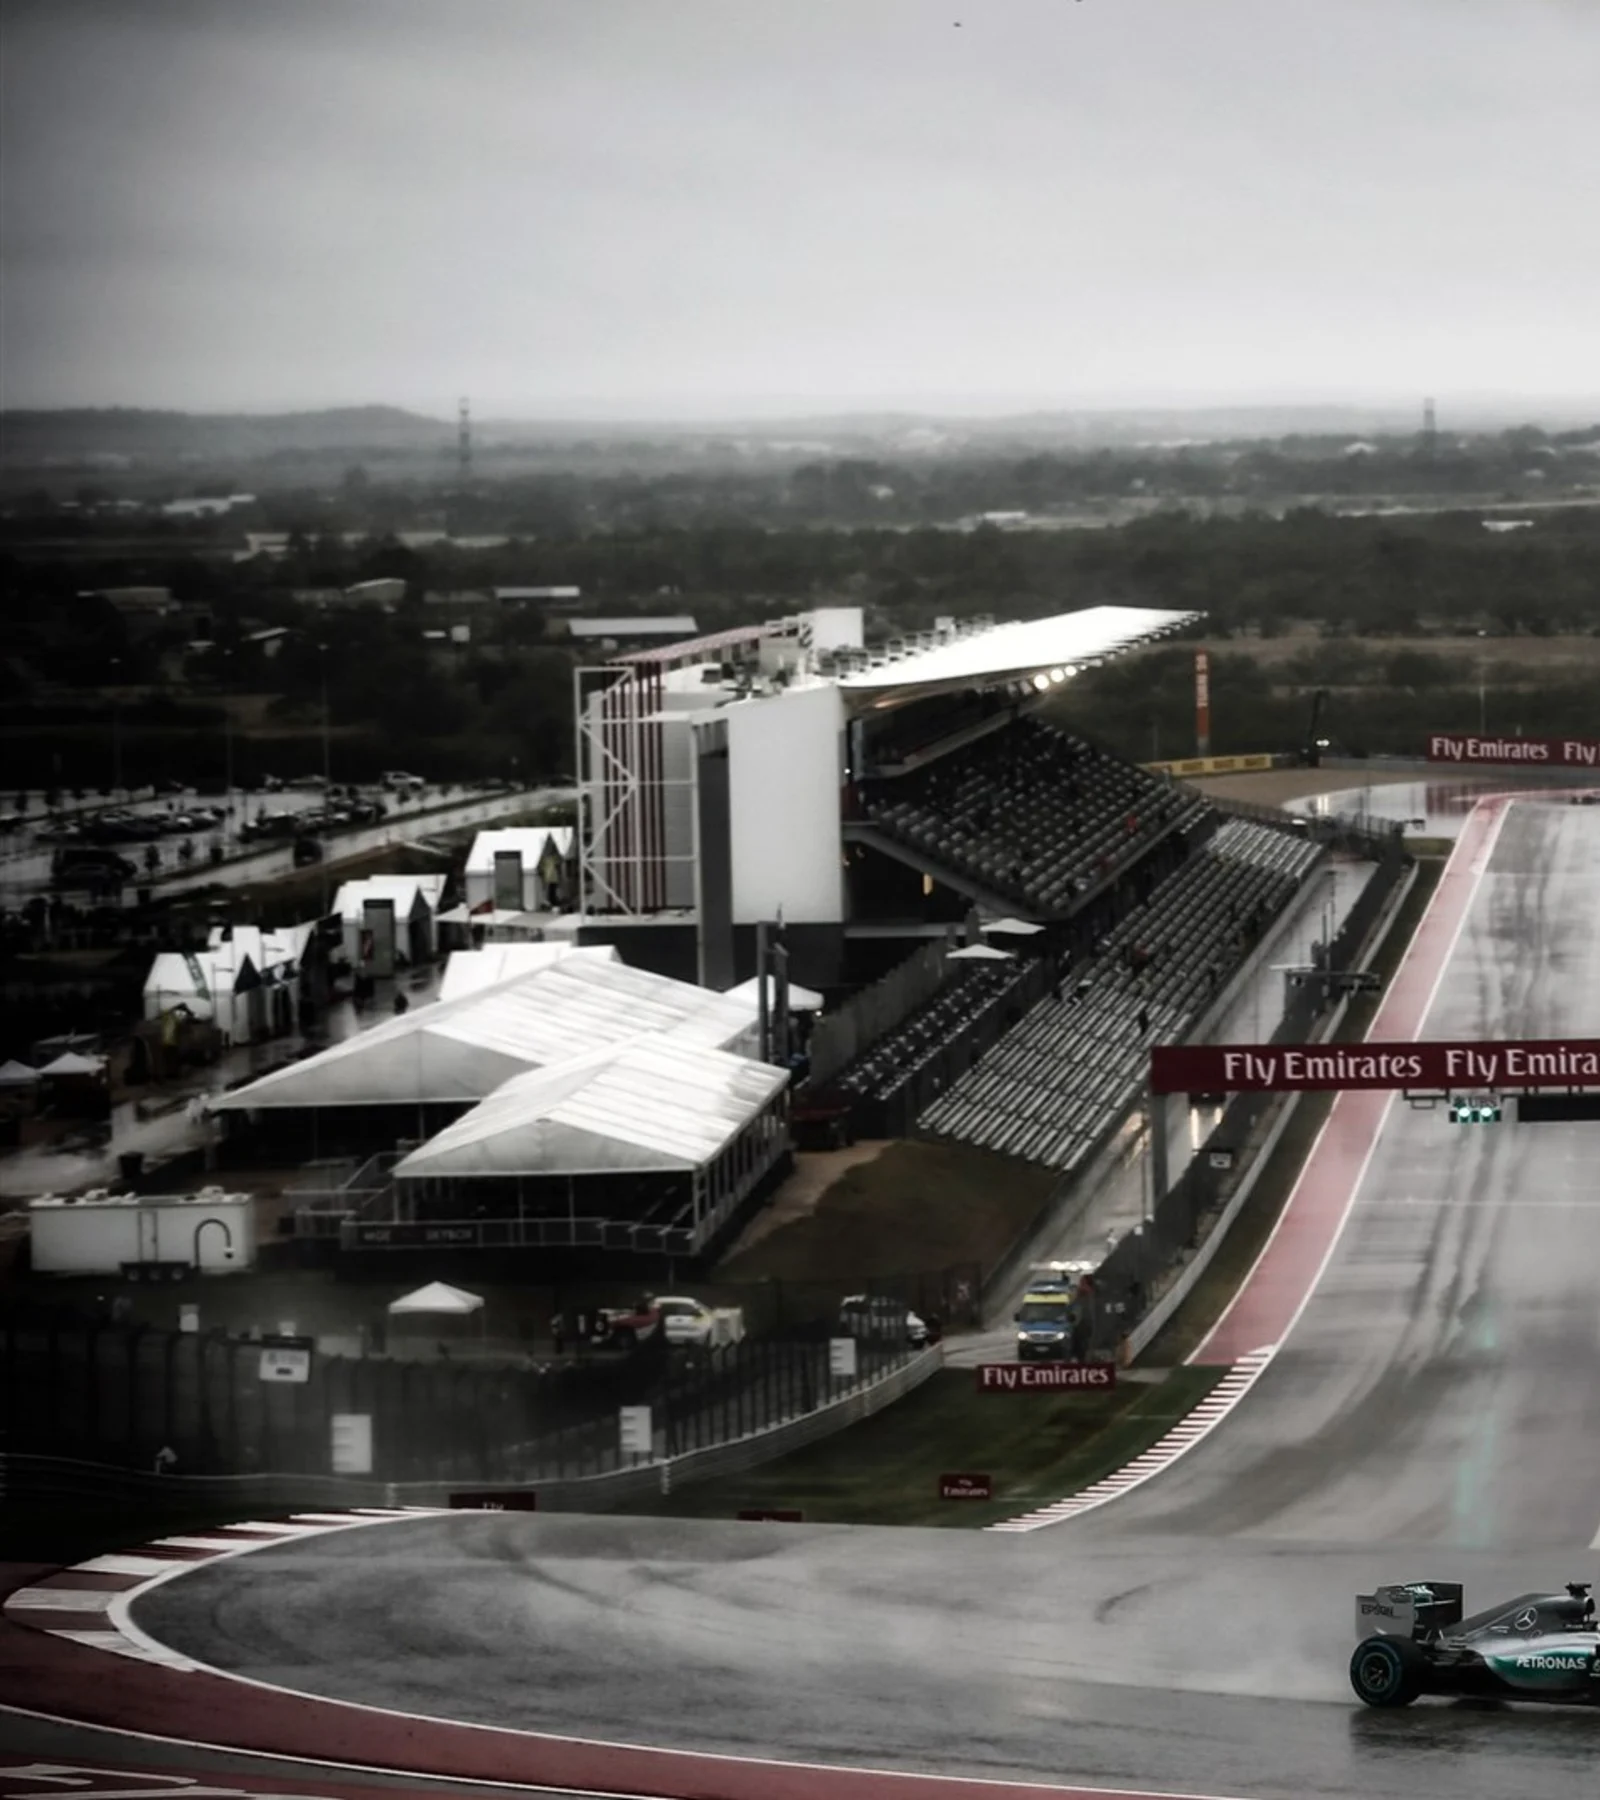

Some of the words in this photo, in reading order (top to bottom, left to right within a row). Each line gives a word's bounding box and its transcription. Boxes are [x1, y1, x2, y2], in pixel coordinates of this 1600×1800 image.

[1431, 736, 1463, 760] Fly
[1466, 739, 1549, 760] Emirates
[1563, 741, 1596, 764] Fly
[1224, 1052, 1276, 1086] Fly
[1284, 1051, 1422, 1080] Emirates
[1445, 1049, 1497, 1083] Fly
[983, 1366, 1017, 1388] Fly
[1021, 1366, 1109, 1385] Emirates
[1515, 1656, 1587, 1670] PETRONAS
